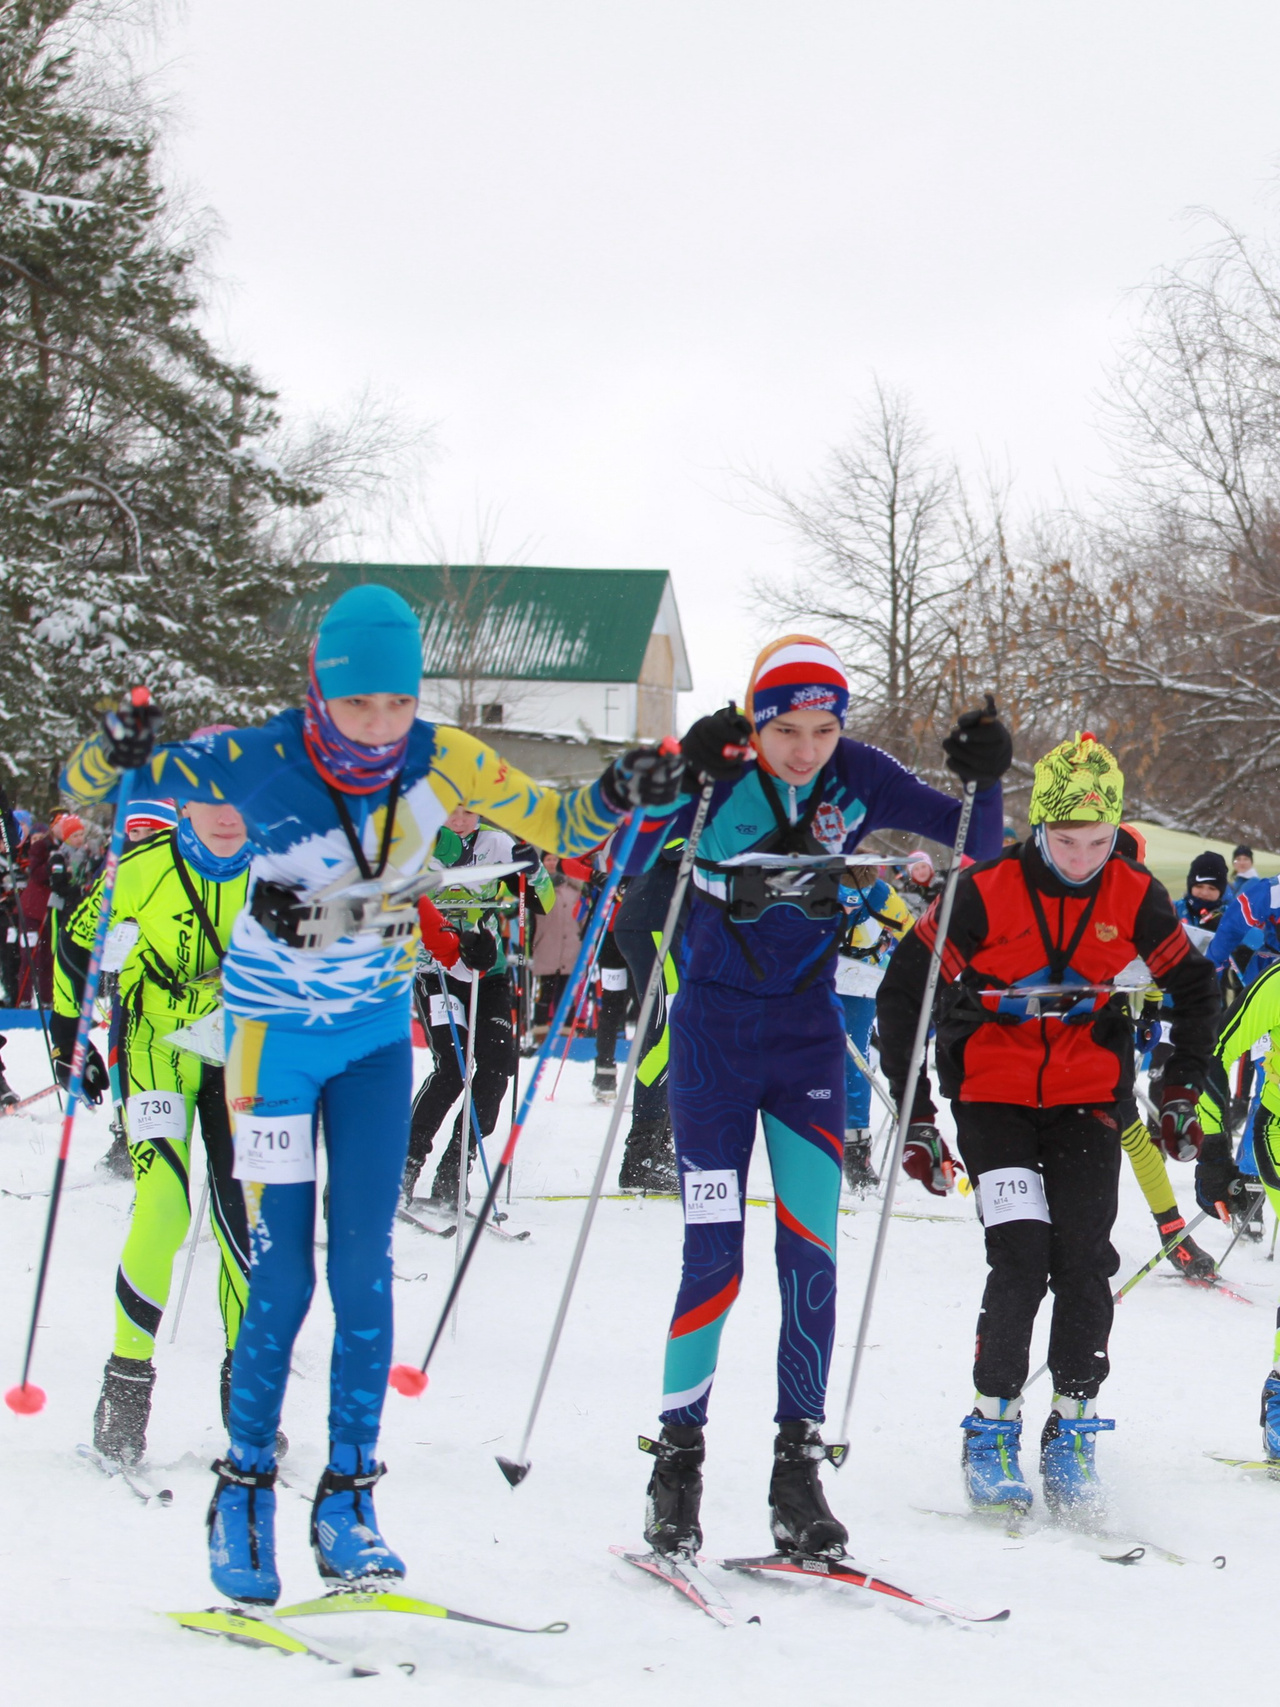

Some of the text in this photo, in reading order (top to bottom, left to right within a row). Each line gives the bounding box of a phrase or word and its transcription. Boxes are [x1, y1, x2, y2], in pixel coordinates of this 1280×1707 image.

[687, 803, 708, 864] NORDWAY
[955, 803, 972, 857] NORDWAY
[809, 1089, 831, 1099] GS
[140, 1100, 171, 1116] 730
[251, 1130, 290, 1150] 710
[692, 1182, 728, 1202] 720
[995, 1180, 1028, 1197] 719
[688, 1202, 704, 1210] M14
[993, 1197, 1009, 1206] M14
[802, 1559, 830, 1575] ROSSIGNOL
